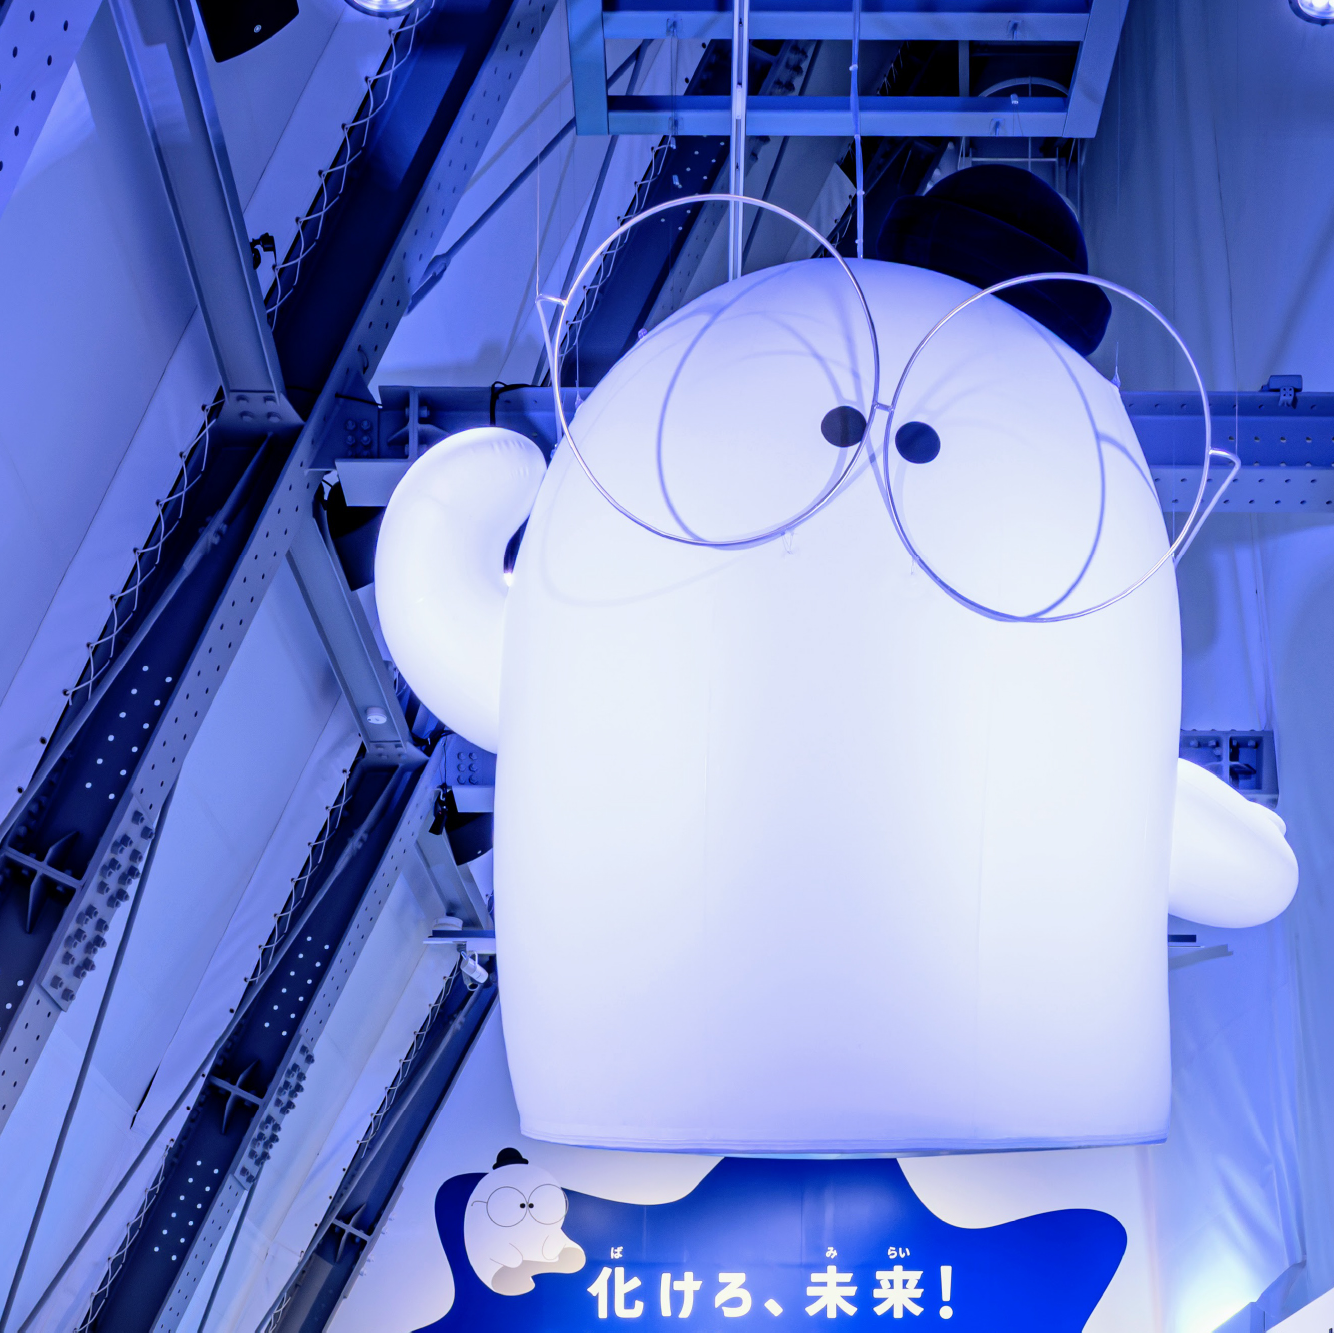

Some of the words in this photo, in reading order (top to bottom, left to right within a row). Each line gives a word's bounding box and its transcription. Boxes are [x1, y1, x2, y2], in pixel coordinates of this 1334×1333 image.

[587, 1265, 953, 1319] 化けろ、未来！
